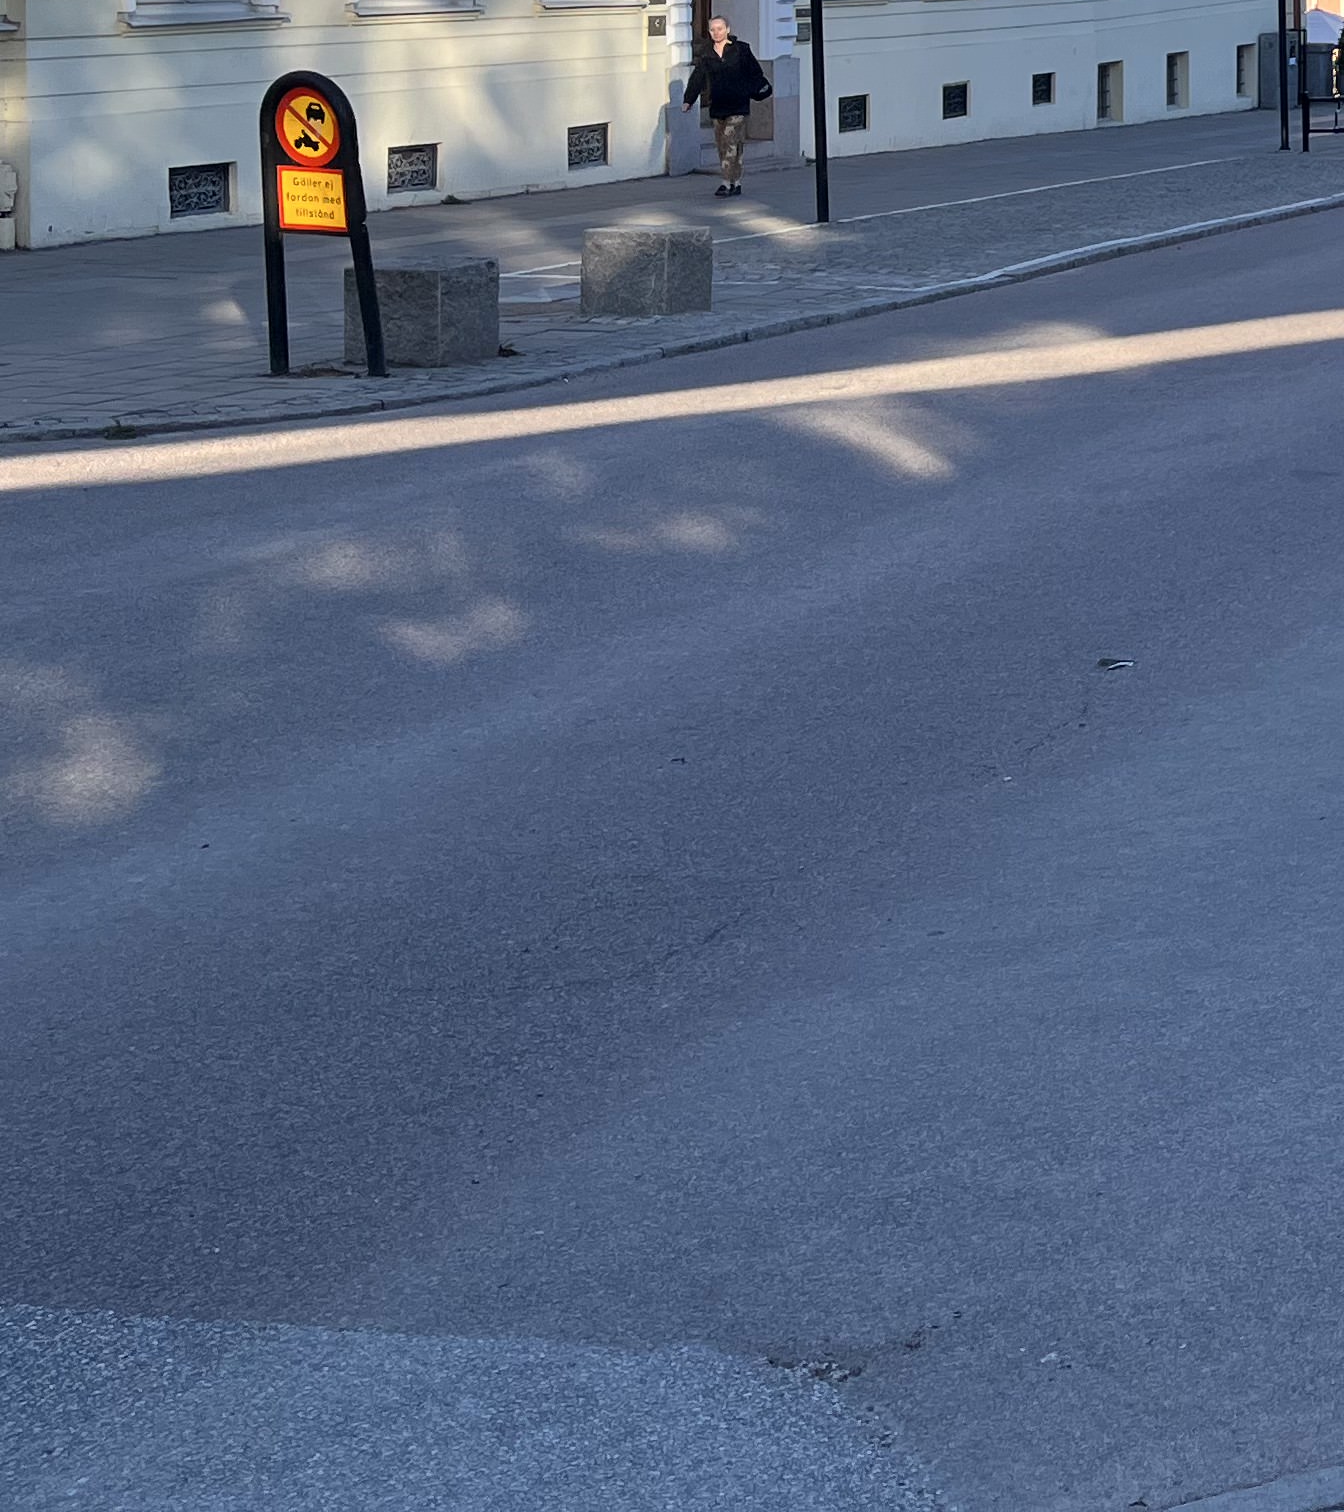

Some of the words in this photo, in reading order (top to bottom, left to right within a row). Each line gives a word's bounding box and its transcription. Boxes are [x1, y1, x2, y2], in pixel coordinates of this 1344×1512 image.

[292, 177, 322, 187] Gäller
[325, 180, 334, 191] ej
[286, 192, 319, 202] fordon
[322, 196, 341, 205] med
[296, 208, 335, 219] tillstånd
